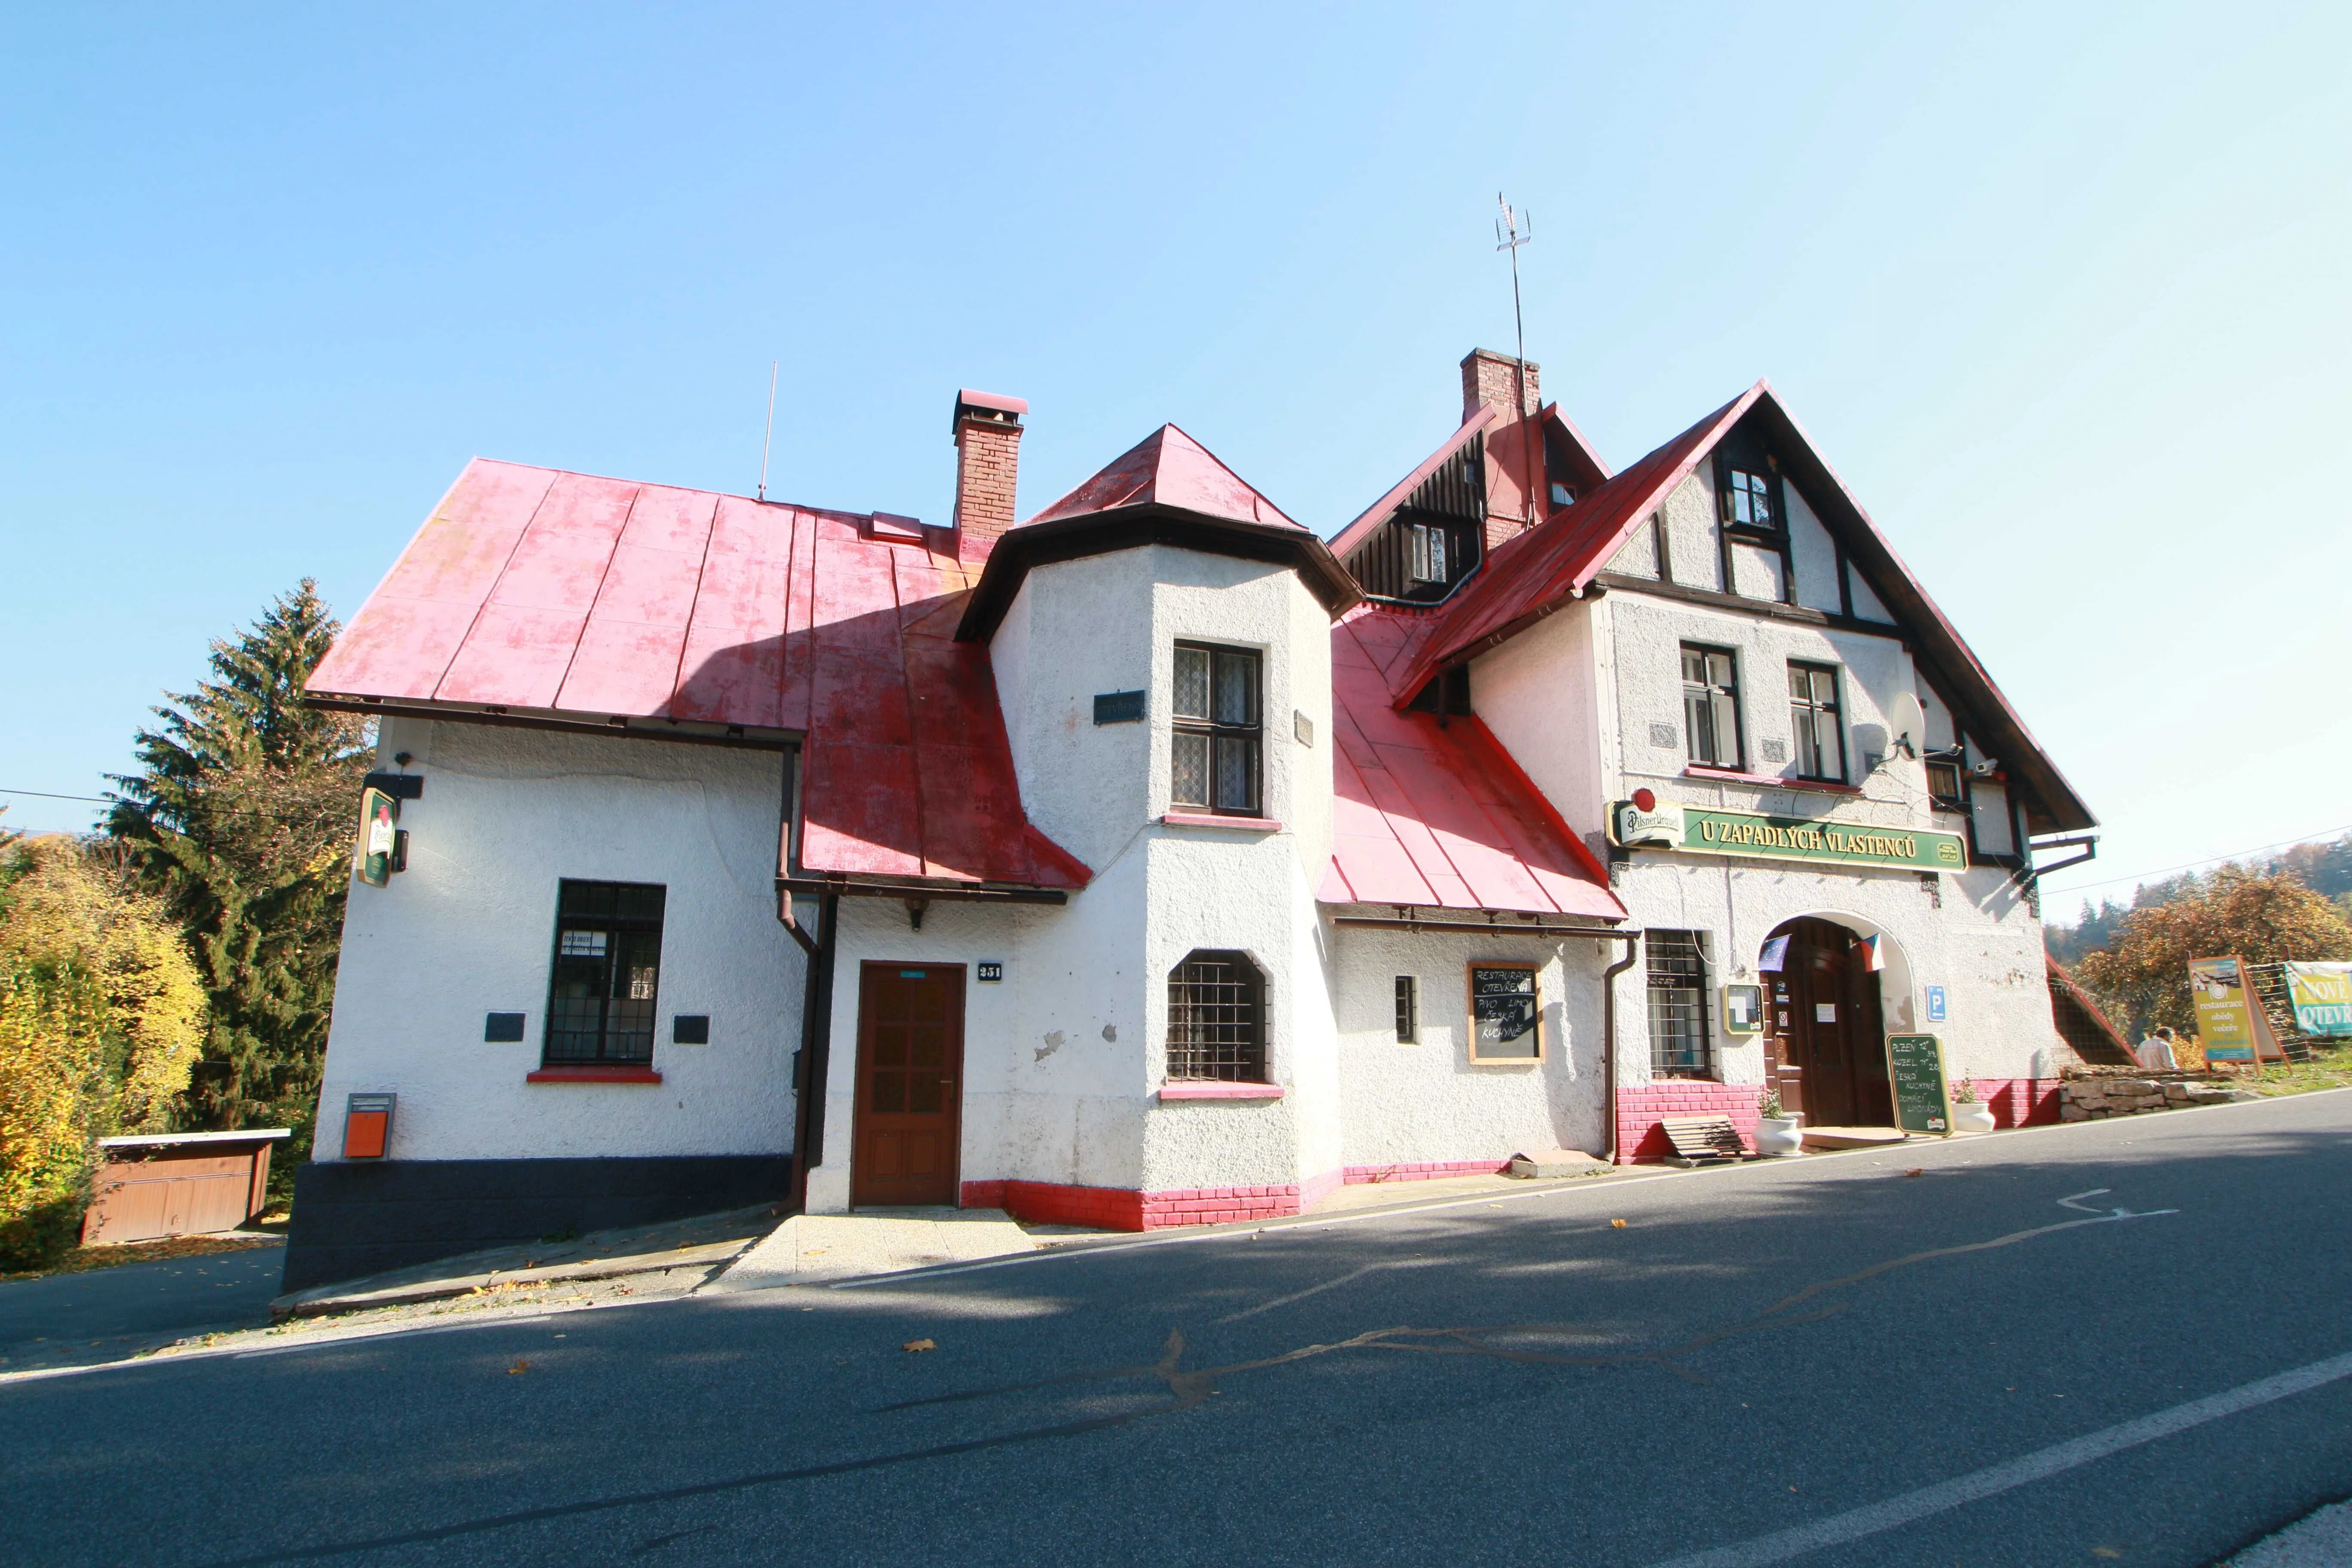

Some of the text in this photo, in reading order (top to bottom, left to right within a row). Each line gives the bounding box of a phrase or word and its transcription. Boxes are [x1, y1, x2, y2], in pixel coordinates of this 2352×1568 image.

[1628, 811, 1678, 833] Pilsner Urquell
[1701, 821, 1714, 841] U
[1718, 822, 1822, 850] ZAPADLÝCH
[1825, 833, 1915, 858] VLASTENCŮ
[980, 967, 1000, 977] 251
[1476, 971, 1532, 980] RESTAURACE
[1482, 981, 1528, 993] OTEVŘENA
[1478, 999, 1528, 1008] PIVO LIMO
[1932, 995, 1942, 1011] P
[2200, 1001, 2243, 1009] restaurace
[1484, 1009, 1516, 1022] ČESKÁ
[2211, 1012, 2234, 1021] obědy
[1482, 1023, 1523, 1039] KUCHYNĚ
[2212, 1023, 2239, 1032] večeře
[1892, 1039, 1916, 1052] PLZEŇ
[1906, 1079, 1936, 1090] KUCHYNĚ
